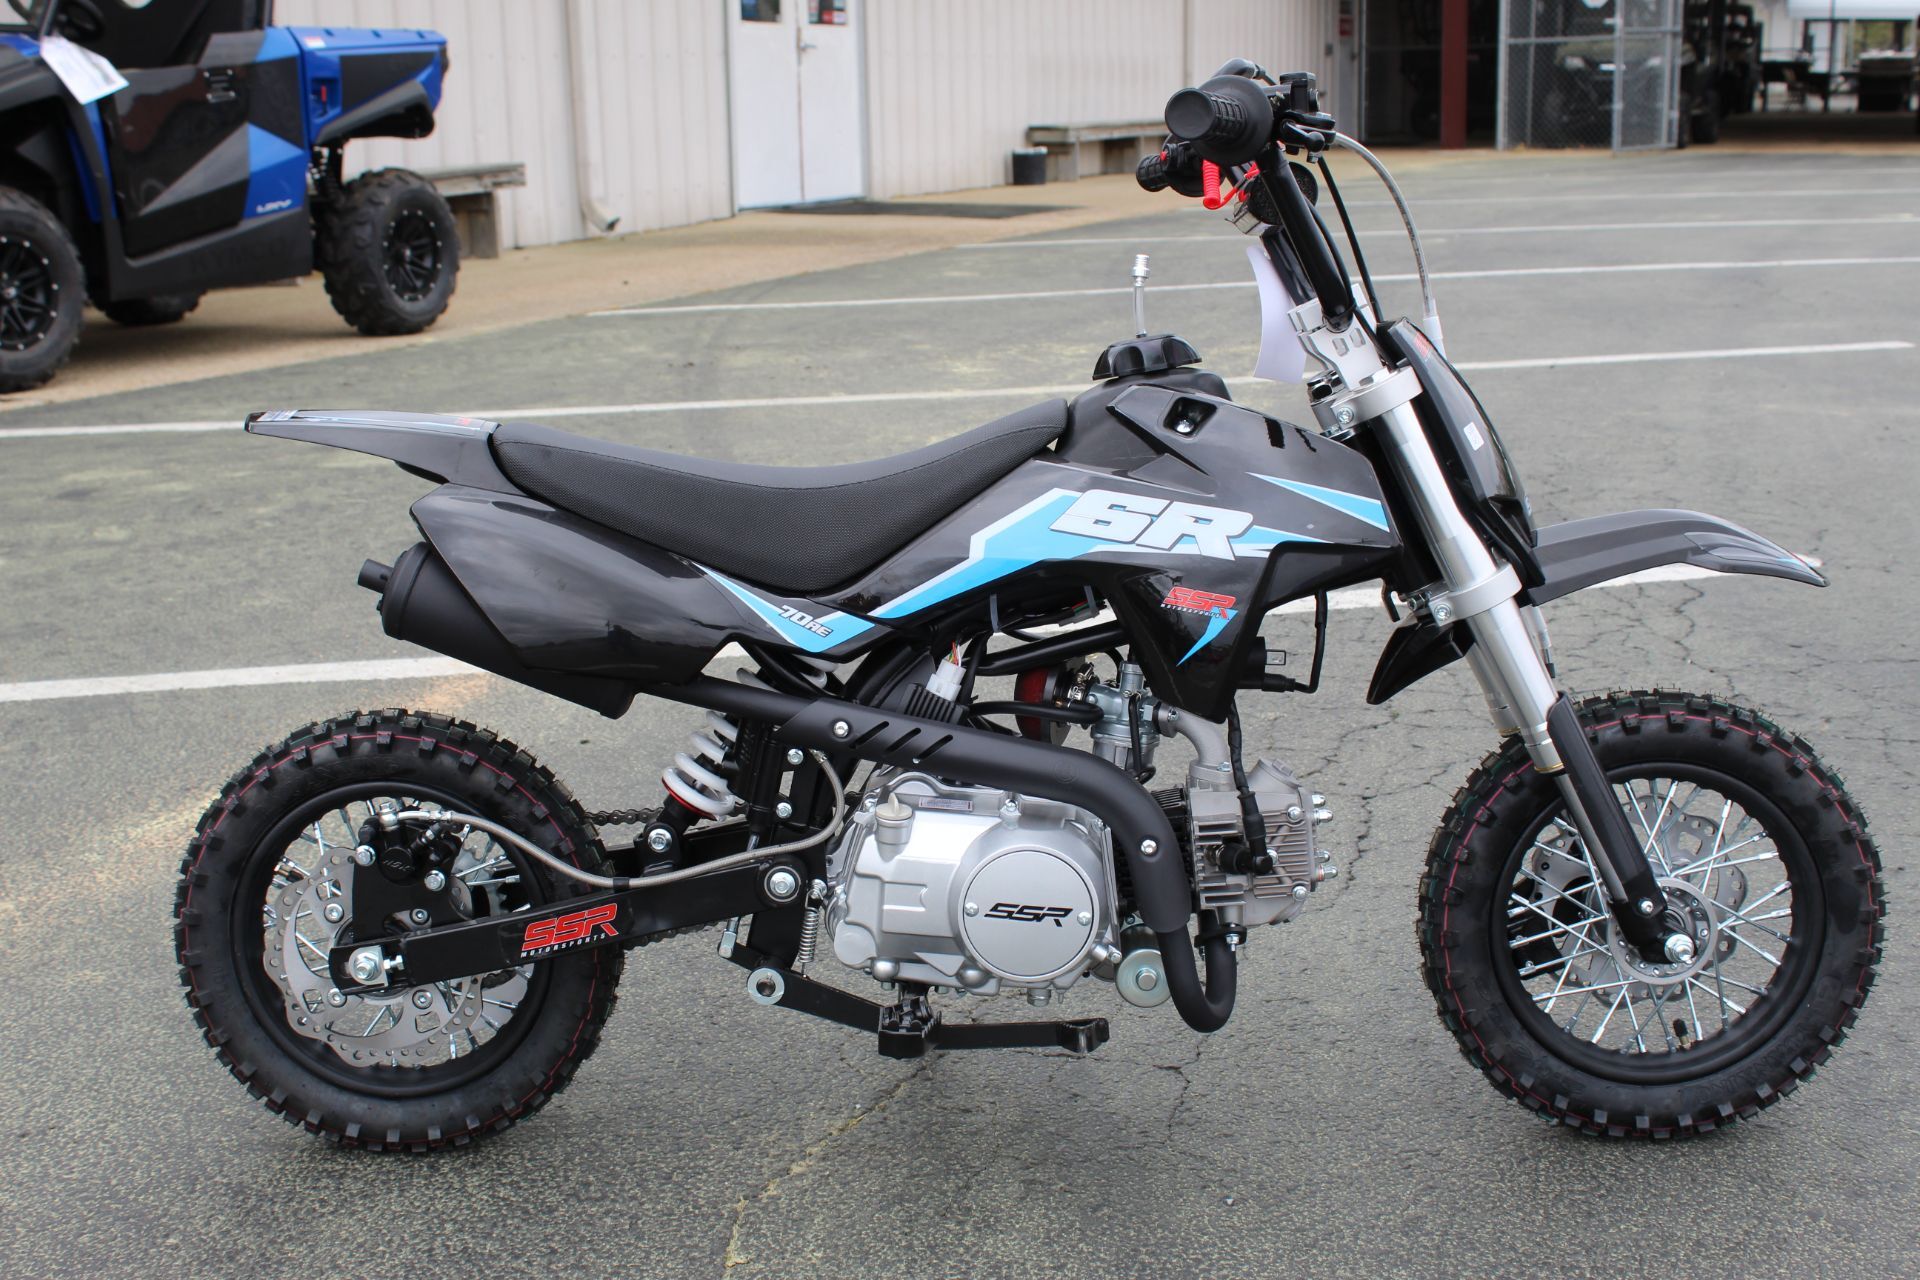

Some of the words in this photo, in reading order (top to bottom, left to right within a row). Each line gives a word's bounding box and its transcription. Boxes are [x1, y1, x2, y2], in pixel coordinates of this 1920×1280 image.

[1160, 603, 1221, 618] MOTORSPORTS
[1163, 586, 1236, 619] SSR
[522, 903, 619, 951] SSR
[984, 902, 1073, 928] SSR
[520, 933, 606, 958] MOTORSPORTS
